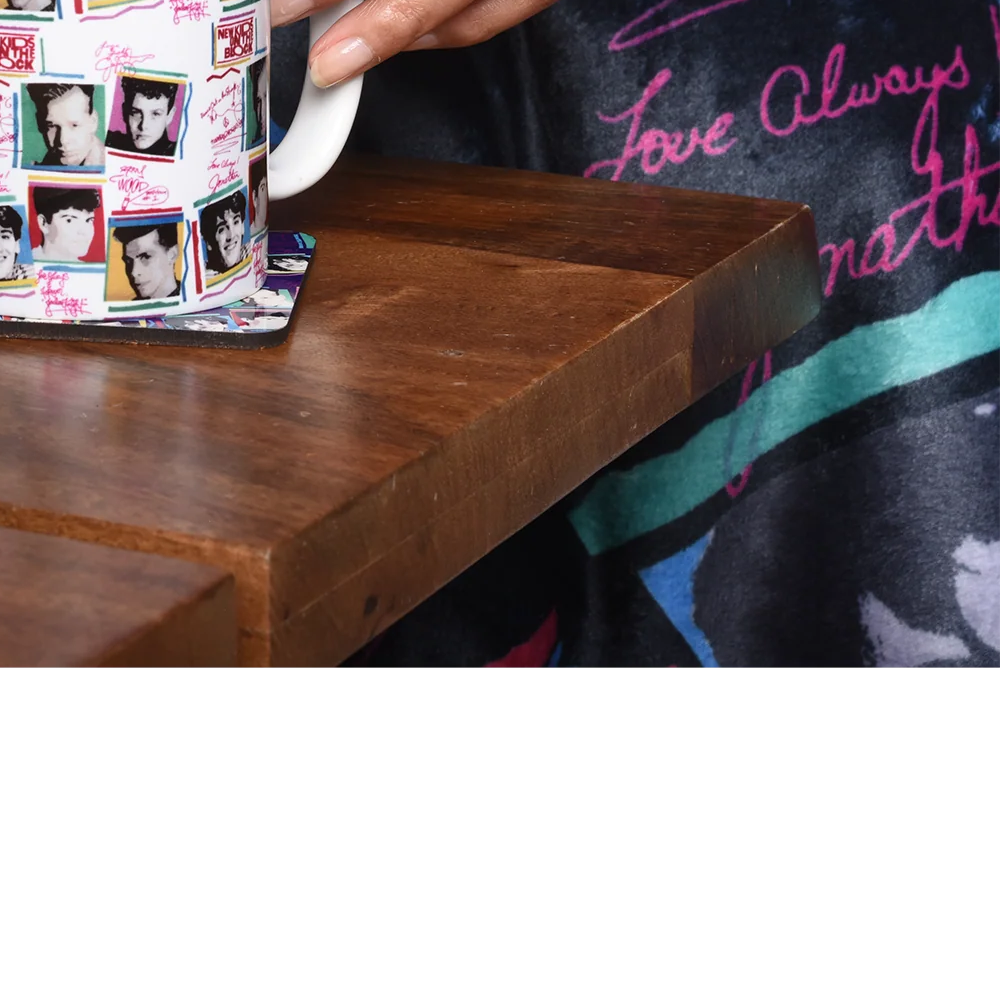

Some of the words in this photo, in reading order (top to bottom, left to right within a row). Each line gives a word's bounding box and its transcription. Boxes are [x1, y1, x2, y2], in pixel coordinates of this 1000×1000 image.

[0, 36, 35, 49] KIDS
[11, 47, 36, 59] THE
[585, 68, 736, 181] Love
[760, 43, 970, 175] Always
